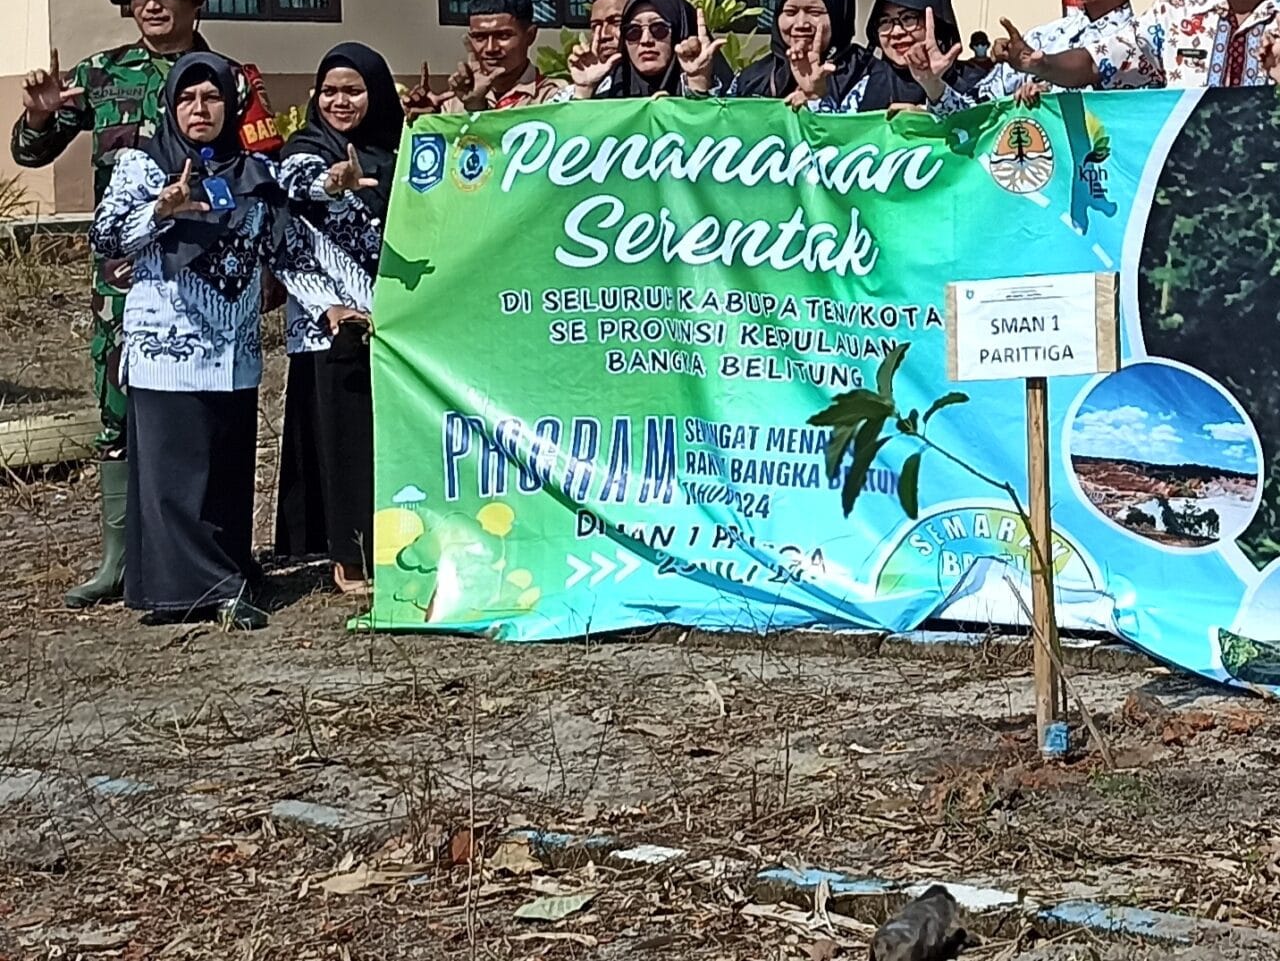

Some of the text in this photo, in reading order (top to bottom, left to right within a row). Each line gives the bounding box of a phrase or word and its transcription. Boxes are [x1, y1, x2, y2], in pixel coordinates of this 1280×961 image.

[1078, 164, 1108, 195] kph
[554, 194, 880, 276] Serentak
[501, 291, 530, 313] DI
[551, 321, 585, 342] SE
[740, 324, 898, 359] KEPULAUAN
[990, 314, 1060, 335] SMAN 1
[979, 344, 1074, 364] PARITTIGA
[721, 355, 863, 387] BELITUNG
[731, 458, 820, 489] BANGKA
[689, 527, 700, 546] 1
